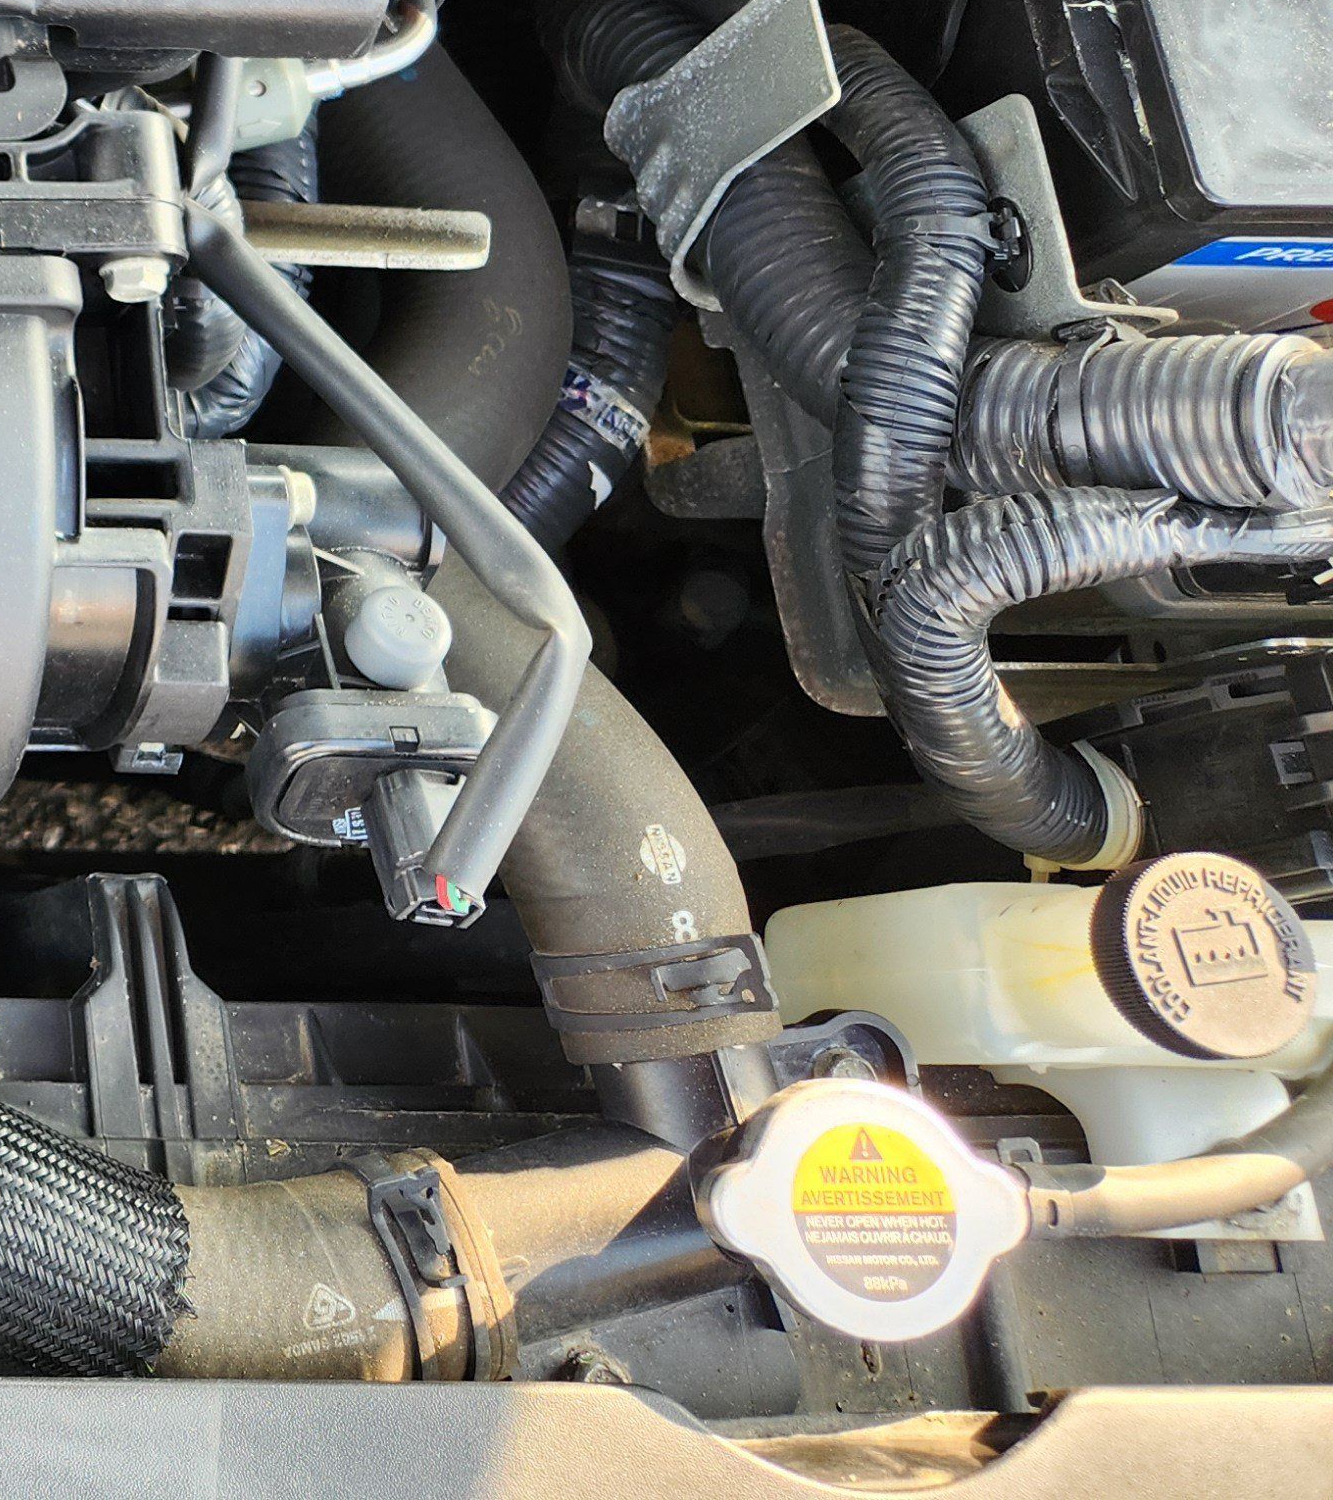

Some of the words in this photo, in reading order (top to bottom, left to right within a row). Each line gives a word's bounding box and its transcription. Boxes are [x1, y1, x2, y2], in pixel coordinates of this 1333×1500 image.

[1233, 247, 1333, 262] PRE
[819, 1165, 918, 1184] WARNING
[801, 1190, 945, 1206] AVERTISSEMENT
[805, 1215, 845, 1228] NEVER
[846, 1215, 878, 1228] OPEN
[881, 1215, 918, 1228] WHEN
[919, 1215, 948, 1228] HOT.
[862, 1254, 898, 1265] MOTOR
